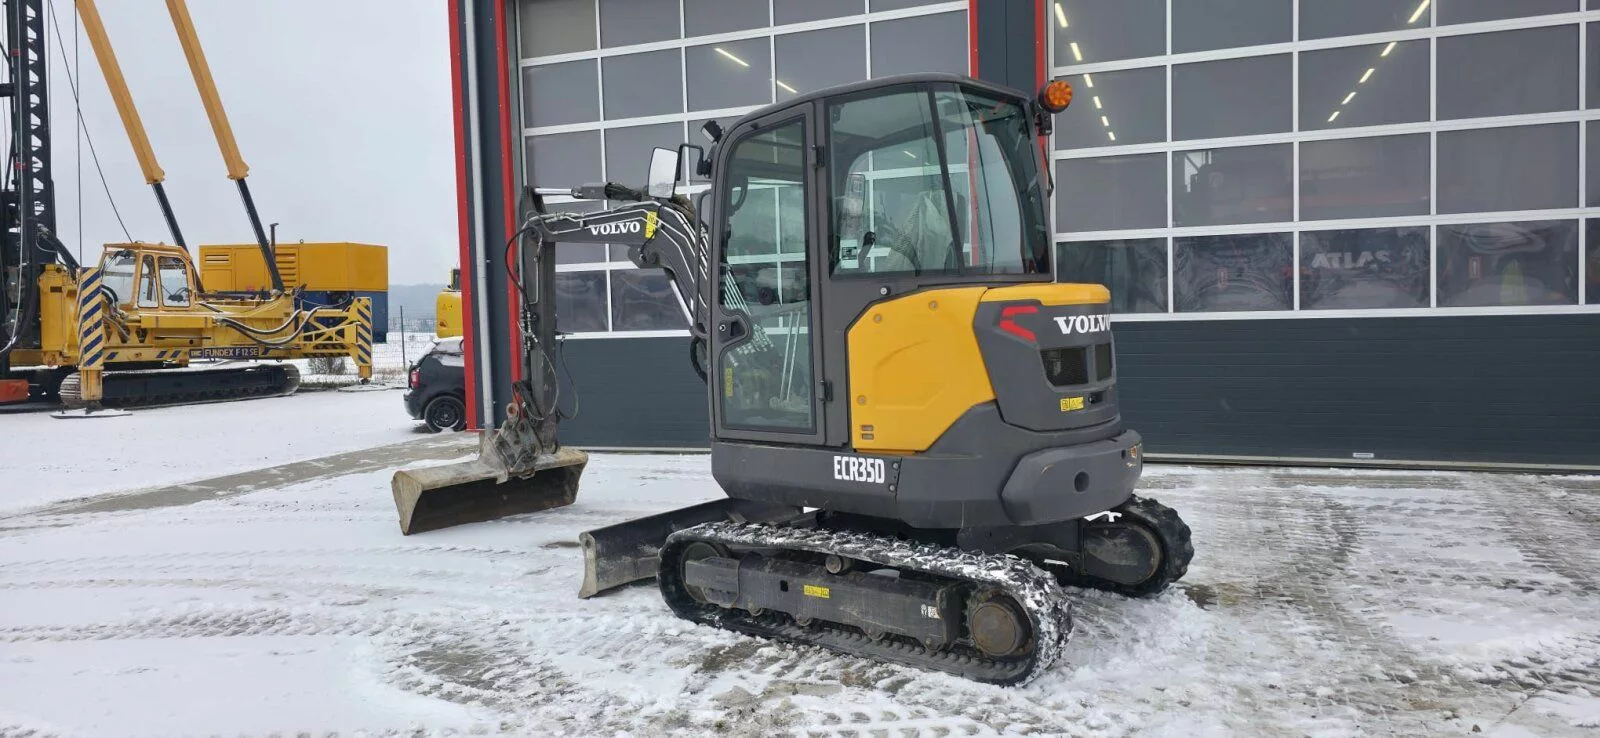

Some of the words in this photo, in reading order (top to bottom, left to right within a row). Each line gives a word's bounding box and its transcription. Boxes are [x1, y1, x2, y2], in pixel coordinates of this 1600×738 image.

[589, 221, 641, 235] VOLVO
[1311, 250, 1391, 269] ATLAS
[204, 348, 234, 357] FUNDEX
[235, 348, 241, 357] F
[241, 348, 249, 357] 12
[250, 347, 259, 356] SE
[833, 455, 885, 484] ECR35D
